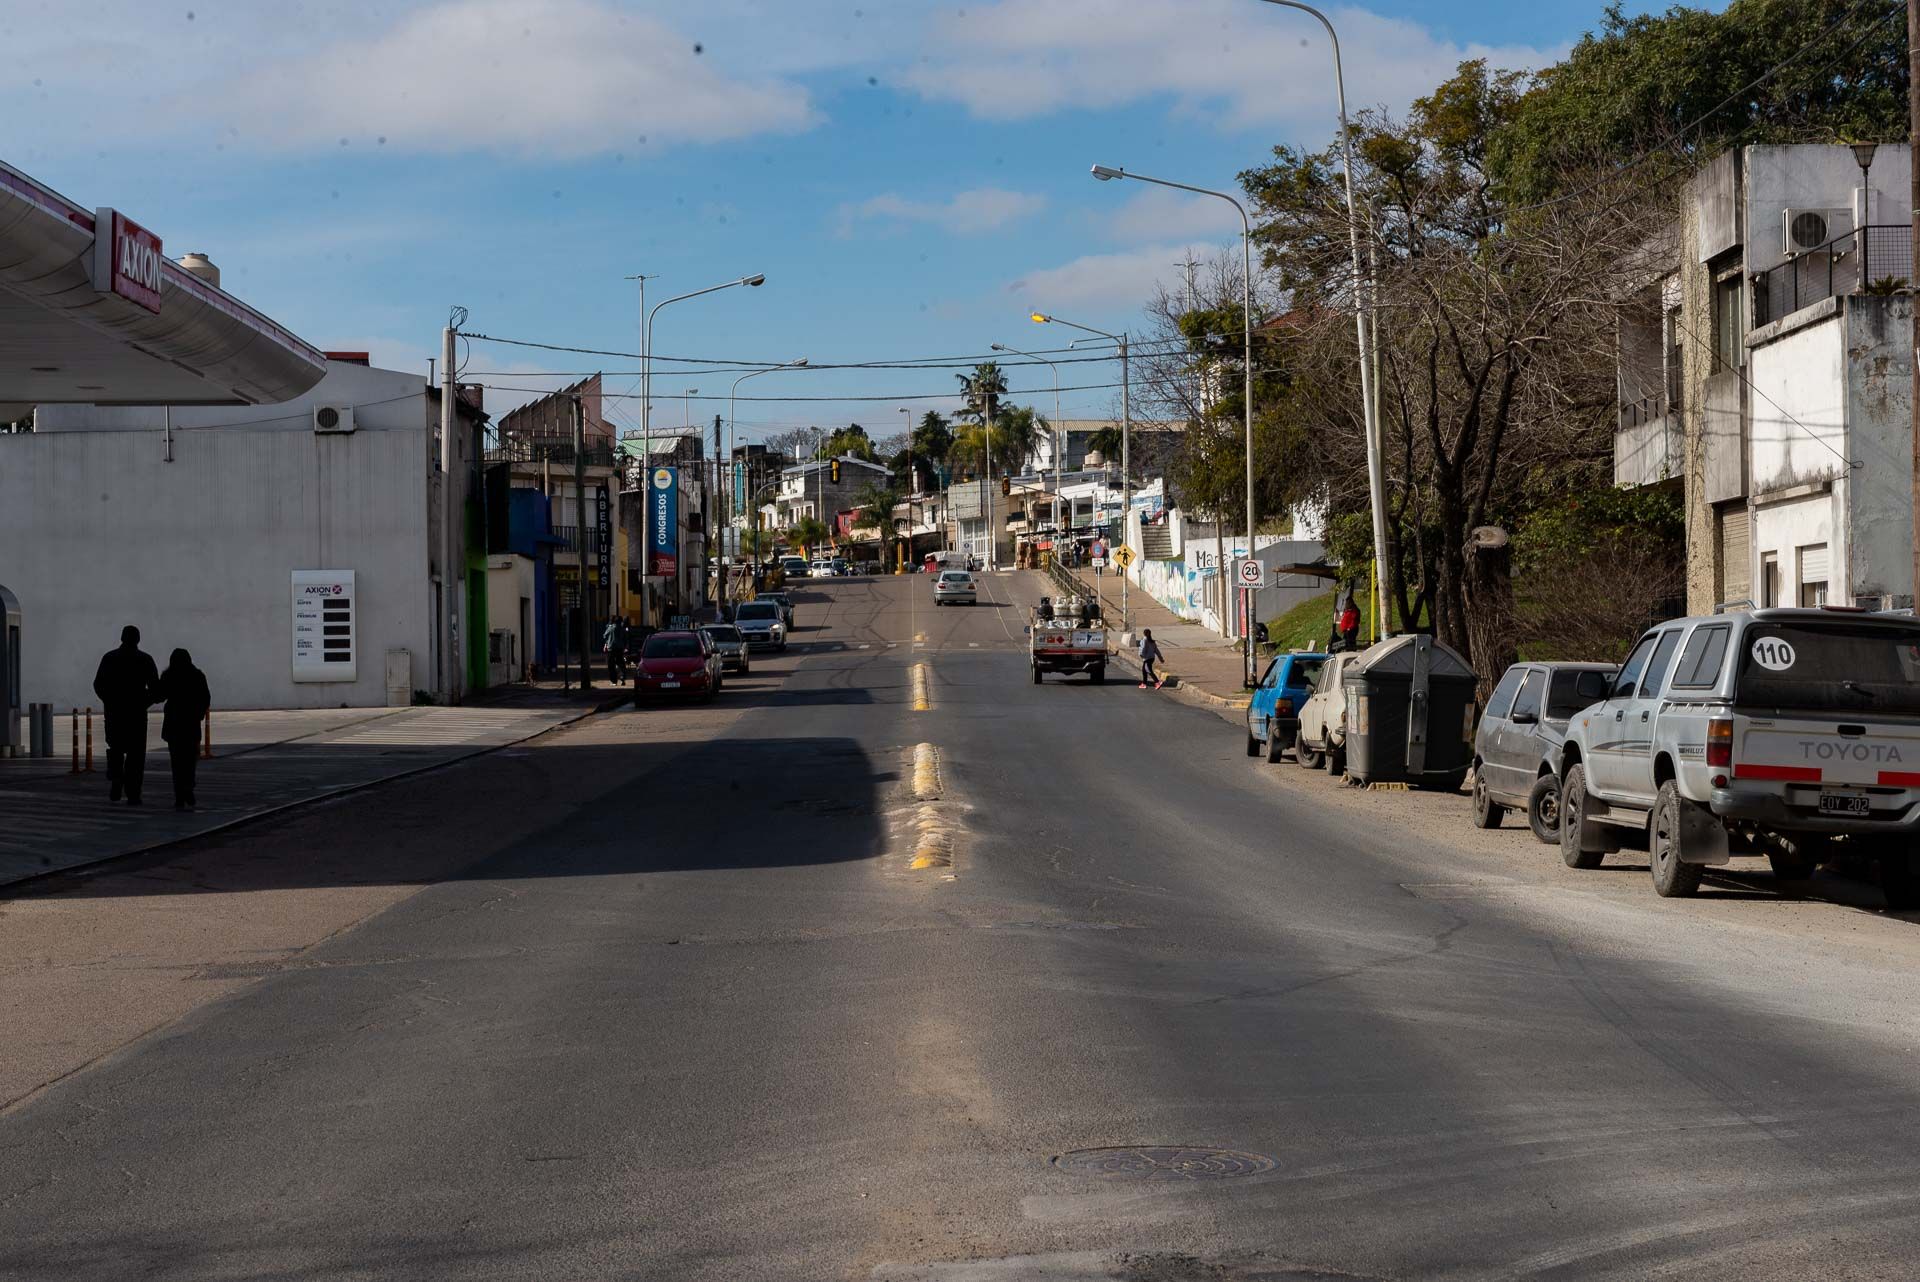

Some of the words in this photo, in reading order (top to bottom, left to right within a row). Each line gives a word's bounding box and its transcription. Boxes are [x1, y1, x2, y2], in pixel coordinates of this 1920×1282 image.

[122, 235, 161, 294] AXION
[658, 494, 667, 545] CONGRESOS
[599, 490, 608, 585] ABERTURAS
[1245, 566, 1257, 576] 20
[1756, 642, 1791, 665] 110
[1799, 741, 1902, 763] TOYOTA
[1820, 796, 1841, 811] EOY
[1847, 797, 1869, 812] 202
